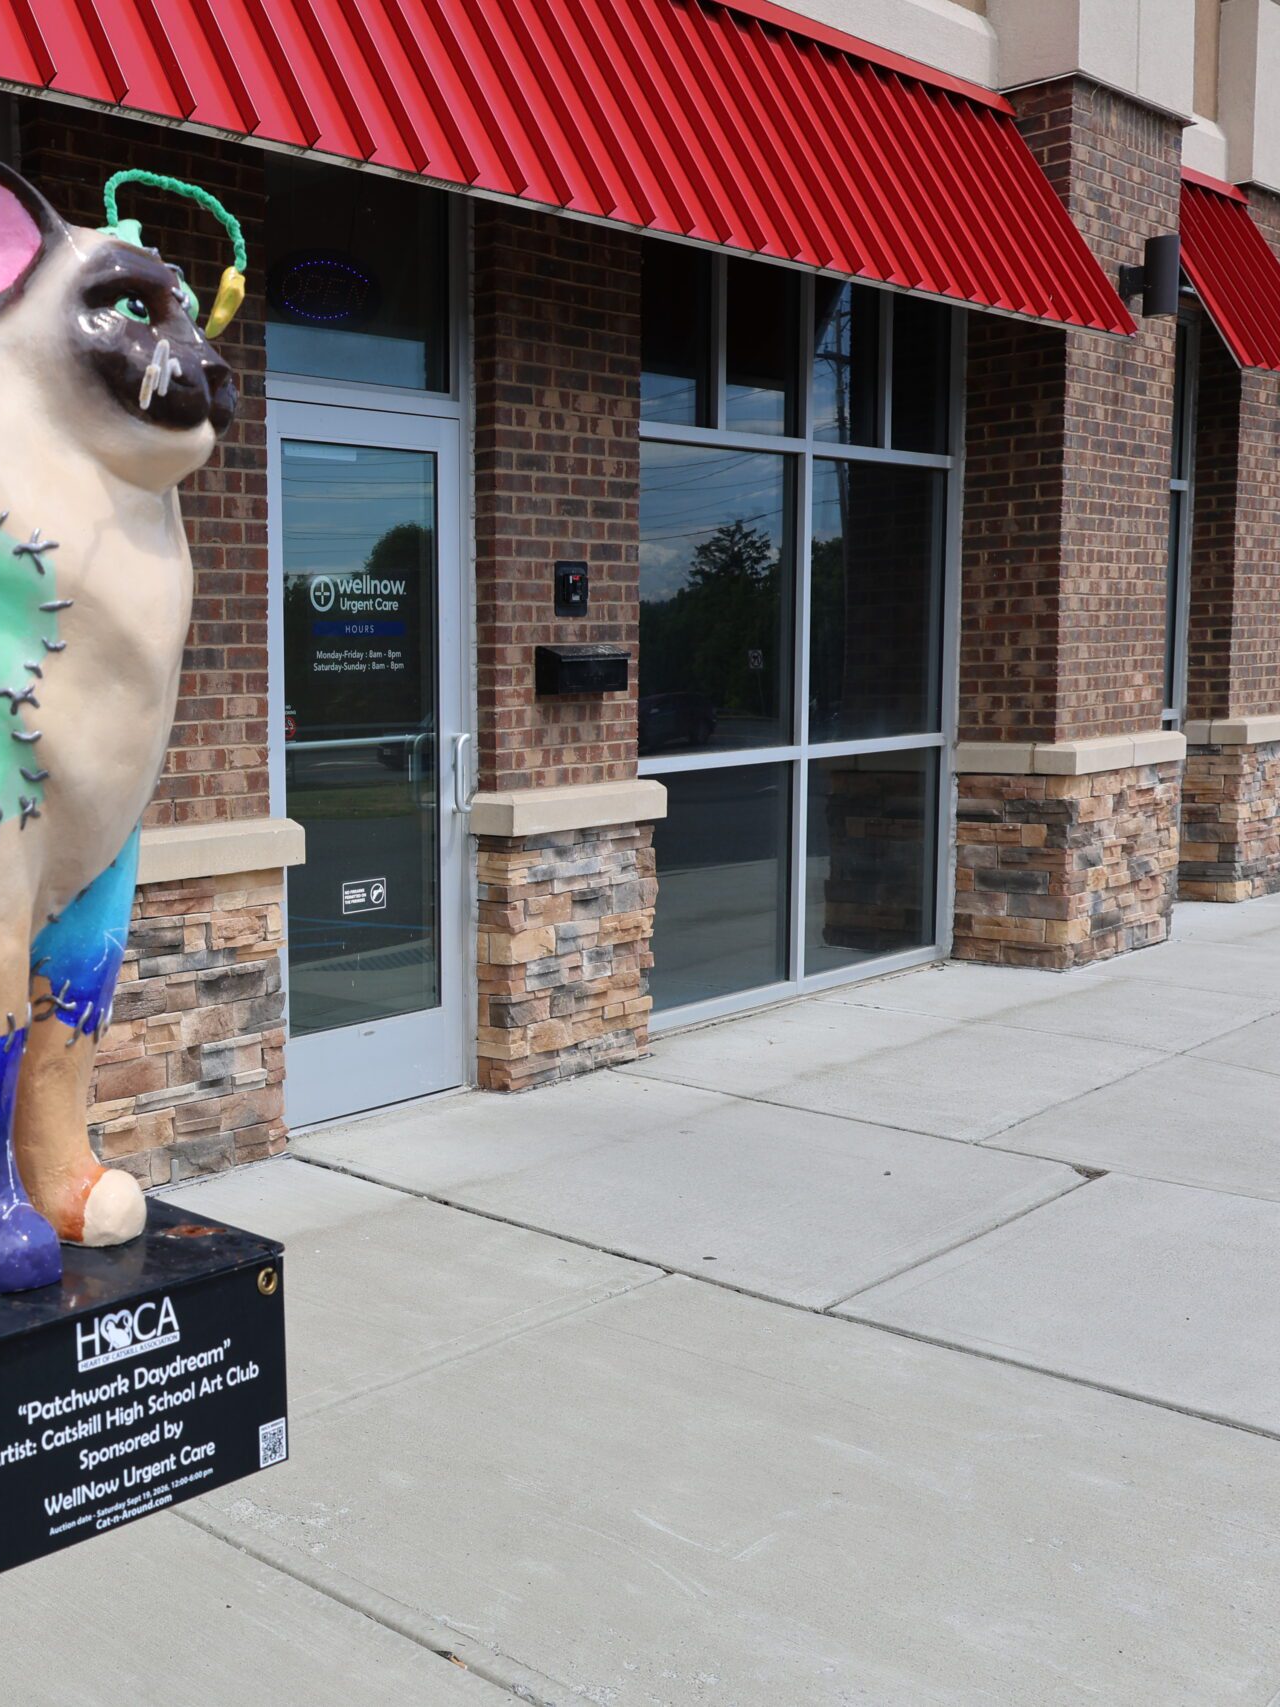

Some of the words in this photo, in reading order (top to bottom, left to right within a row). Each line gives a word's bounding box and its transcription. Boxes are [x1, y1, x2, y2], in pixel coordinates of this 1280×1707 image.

[340, 597, 373, 614] Urgent
[375, 598, 399, 611] Care
[345, 625, 375, 634] HOURS
[313, 662, 367, 672] Saturday-Sunday
[371, 662, 385, 670] 8am
[390, 661, 405, 671] 8pm
[316, 650, 364, 660] Monday-Friday
[369, 650, 382, 658] 8am
[387, 650, 402, 660] 8pm
[80, 1357, 101, 1369] HEART
[103, 1355, 111, 1363] OF
[111, 1346, 138, 1361] CATSKILL
[140, 1334, 178, 1352] ASSOCIATION
[18, 1374, 129, 1425] “Patchwork
[134, 1338, 231, 1390] Daydream”
[41, 1413, 102, 1450] Catskill
[106, 1401, 144, 1429] High
[148, 1381, 195, 1415] School
[200, 1374, 223, 1397] Art
[226, 1361, 259, 1386] Club
[79, 1423, 160, 1470] Sponsored
[163, 1420, 183, 1439] by
[44, 1478, 119, 1516] WellNow
[123, 1453, 177, 1487] Urgent
[180, 1442, 215, 1465] Care
[49, 1520, 76, 1536] Auction
[77, 1514, 93, 1525] date
[96, 1502, 126, 1518] Saturday
[126, 1495, 142, 1507] Sept
[203, 1467, 214, 1478] pm
[96, 1494, 173, 1530] Cat-n-Around.com
